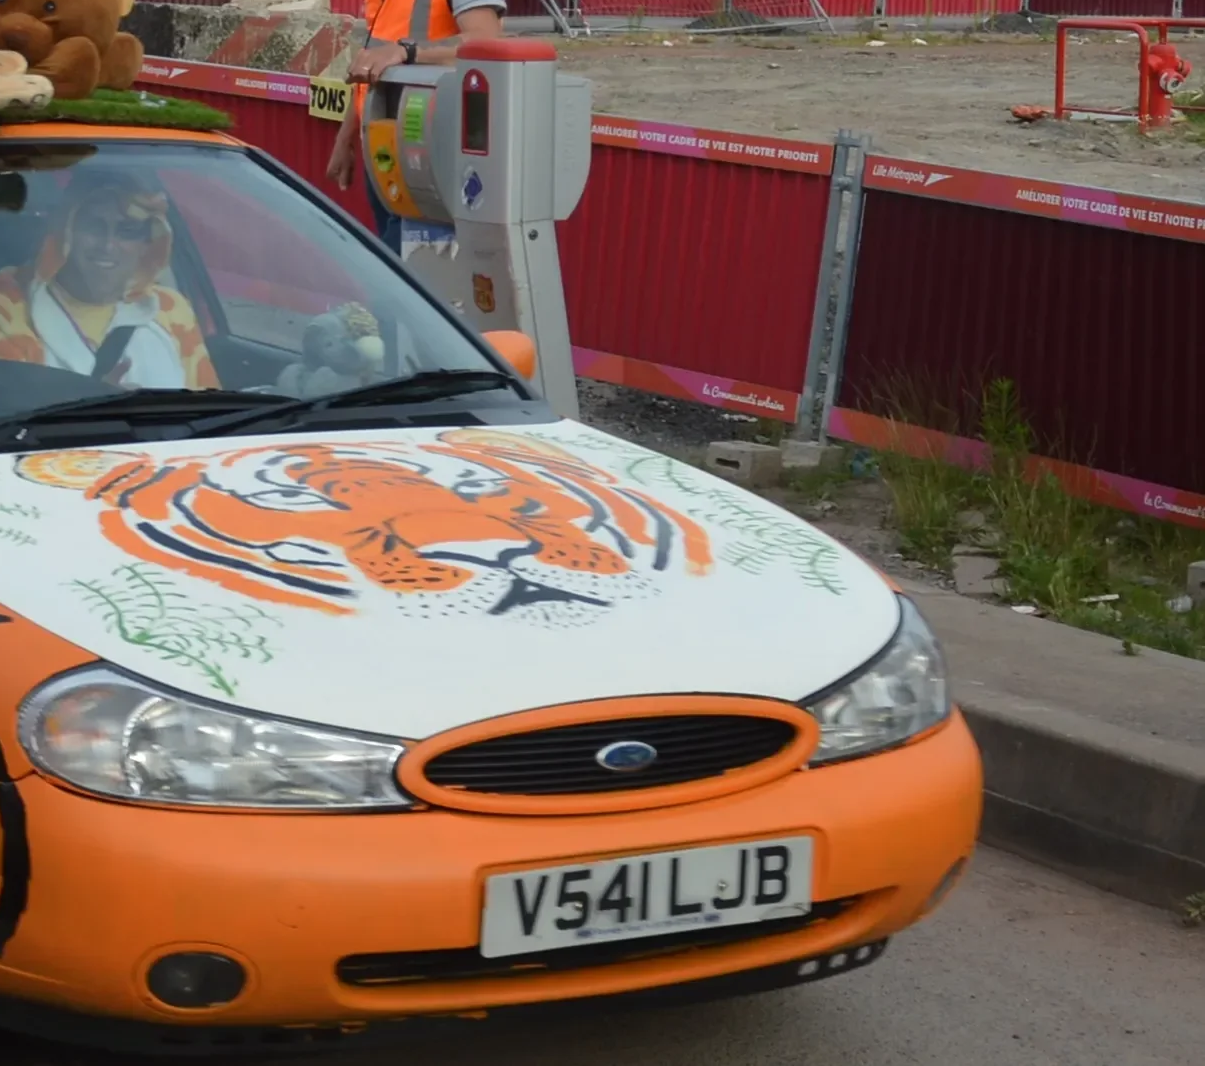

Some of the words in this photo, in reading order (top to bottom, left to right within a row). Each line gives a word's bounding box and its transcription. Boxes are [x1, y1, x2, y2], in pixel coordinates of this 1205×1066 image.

[310, 84, 346, 114] TONS
[639, 130, 666, 143] VOTRE
[668, 134, 696, 147] CADRE
[698, 137, 711, 149] DE
[712, 139, 727, 152] VIE
[728, 142, 743, 153] EST
[745, 144, 776, 158] NOTRE
[1061, 196, 1089, 211] VOTRE
[1090, 201, 1117, 216] CADRE
[1119, 206, 1131, 218] DE
[1132, 208, 1147, 221] VIE
[1148, 212, 1163, 224] EST
[1165, 214, 1195, 229] NOTRE
